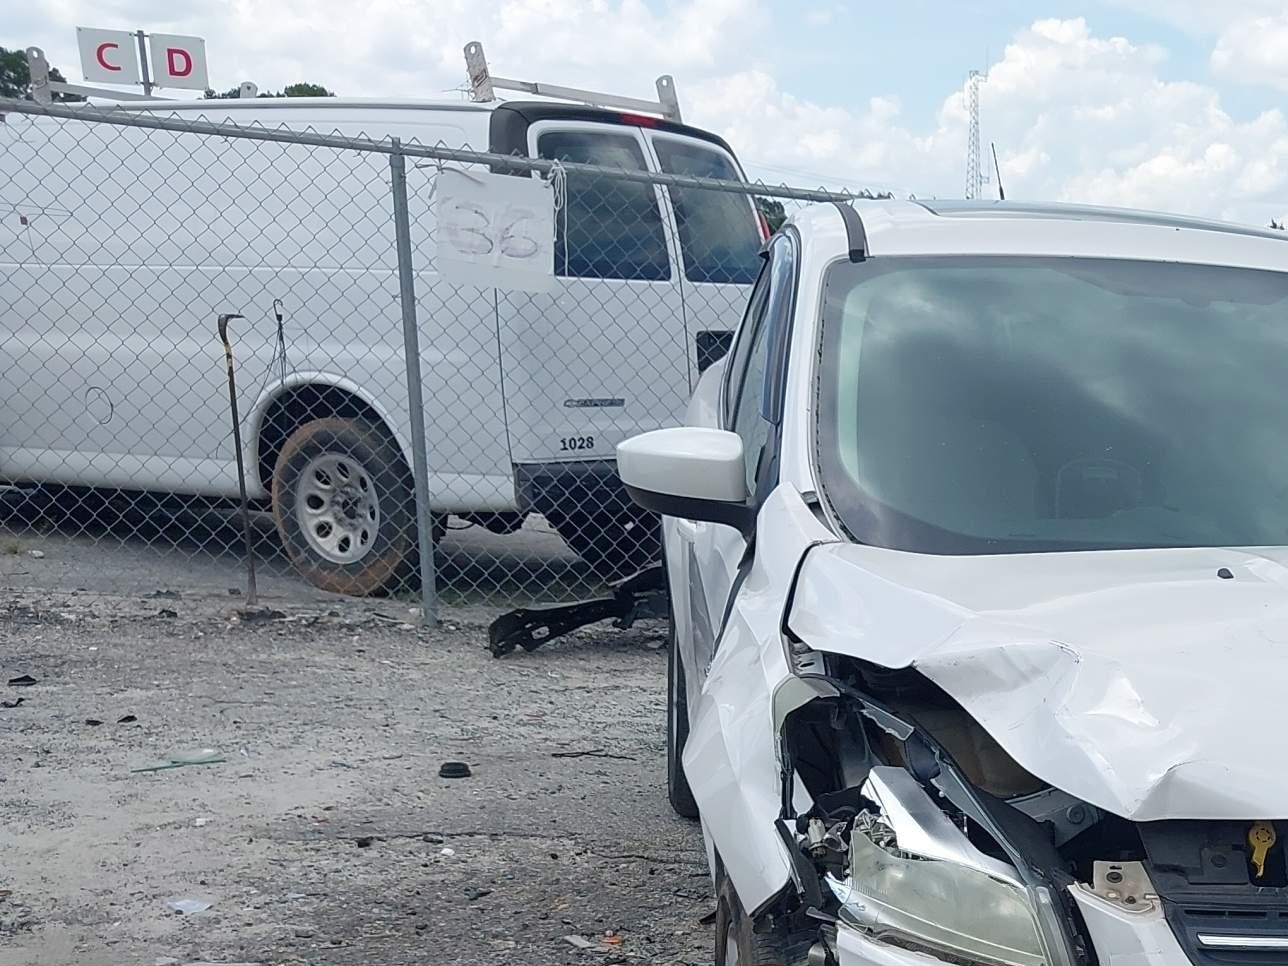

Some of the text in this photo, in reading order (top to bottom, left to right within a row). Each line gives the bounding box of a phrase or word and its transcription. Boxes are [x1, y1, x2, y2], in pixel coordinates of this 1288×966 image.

[96, 42, 122, 71] C
[166, 47, 193, 77] D
[560, 436, 594, 452] 1028
